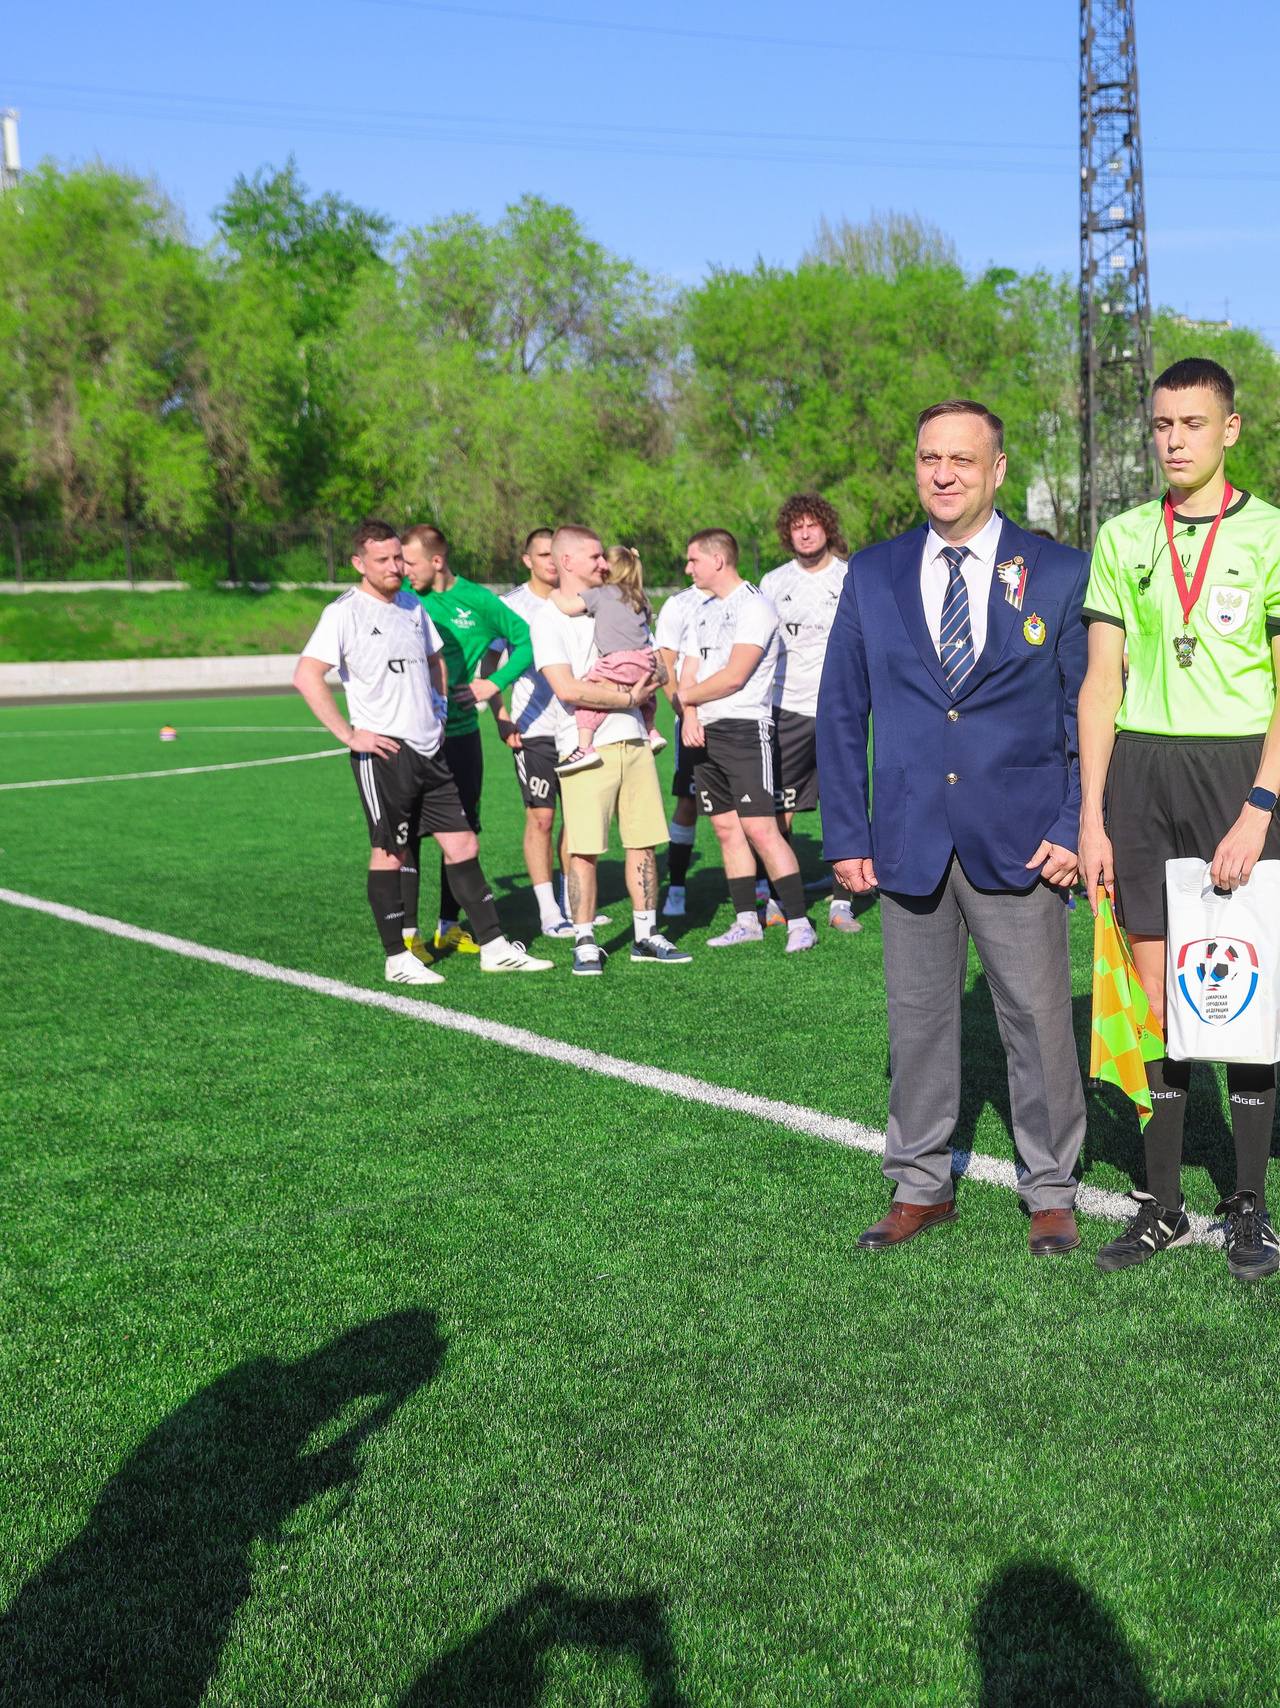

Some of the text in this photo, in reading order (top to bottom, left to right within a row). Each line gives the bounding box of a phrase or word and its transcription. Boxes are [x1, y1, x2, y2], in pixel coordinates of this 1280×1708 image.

[529, 776, 550, 799] 90
[701, 791, 713, 812] 5
[396, 822, 409, 845] 3
[1149, 1091, 1182, 1099] ÖGEL
[1230, 1094, 1265, 1105] JÖGEL
